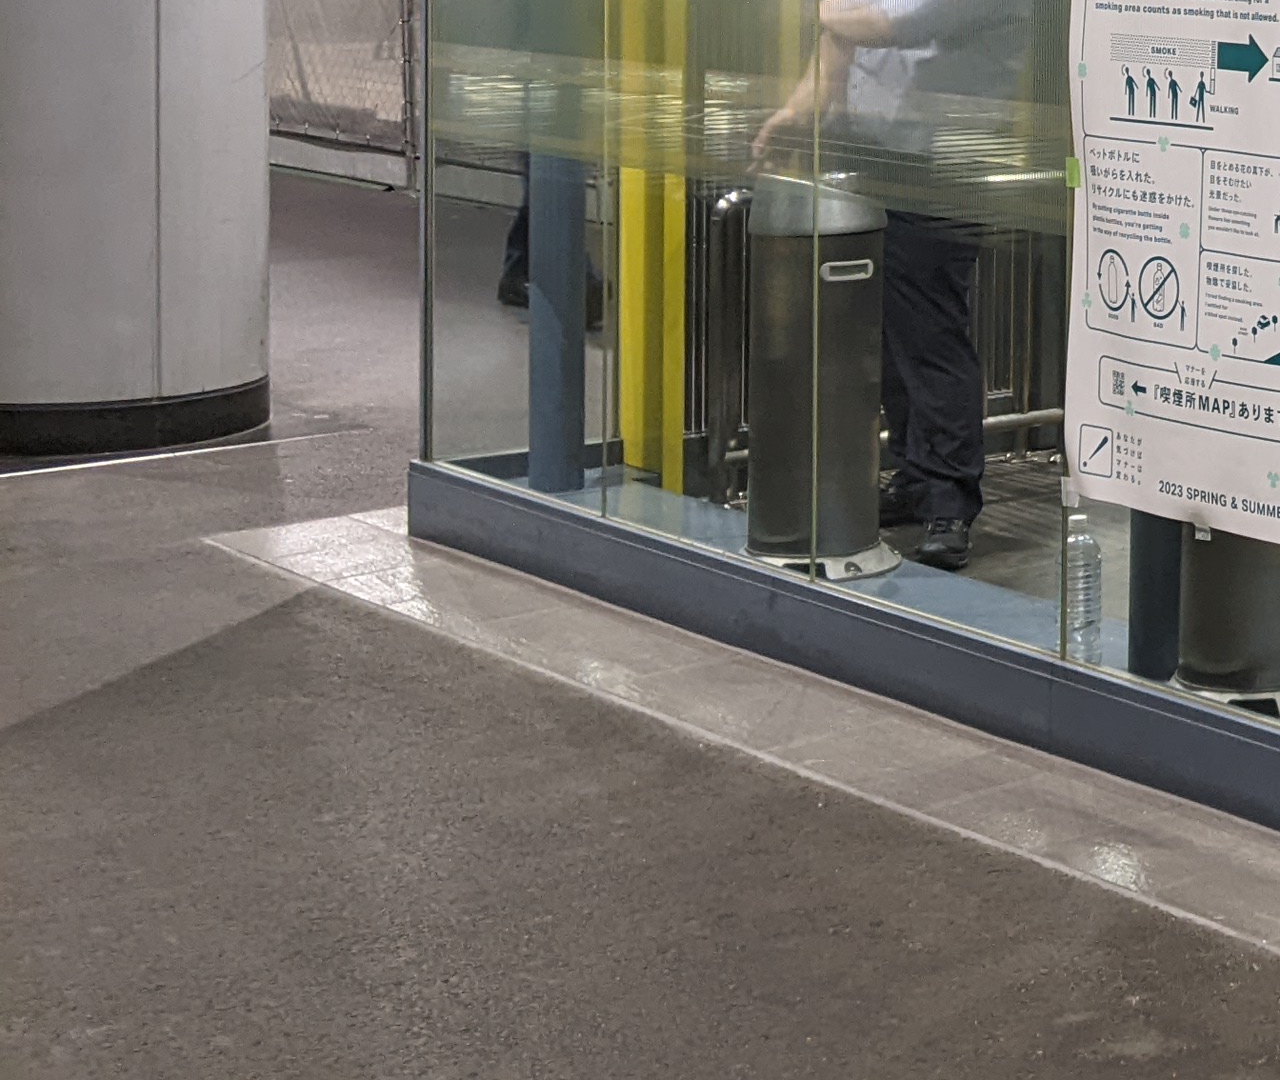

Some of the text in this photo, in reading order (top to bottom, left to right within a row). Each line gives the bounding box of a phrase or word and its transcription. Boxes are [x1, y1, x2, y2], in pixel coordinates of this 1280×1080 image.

[1095, 2, 1122, 13] smoking
[1124, 5, 1140, 13] area
[1142, 6, 1170, 15] counts
[1183, 8, 1214, 19] smoking
[1216, 10, 1231, 19] that
[1233, 11, 1238, 19] is
[1240, 12, 1250, 20] not
[1251, 12, 1279, 23] allowed.
[1150, 46, 1177, 56] SMOKE
[1209, 105, 1239, 115] WALKING
[1089, 148, 1140, 163] ペットボトルに
[1158, 480, 1183, 498] 2023
[1186, 487, 1227, 507] SPRING
[1230, 496, 1238, 510] &
